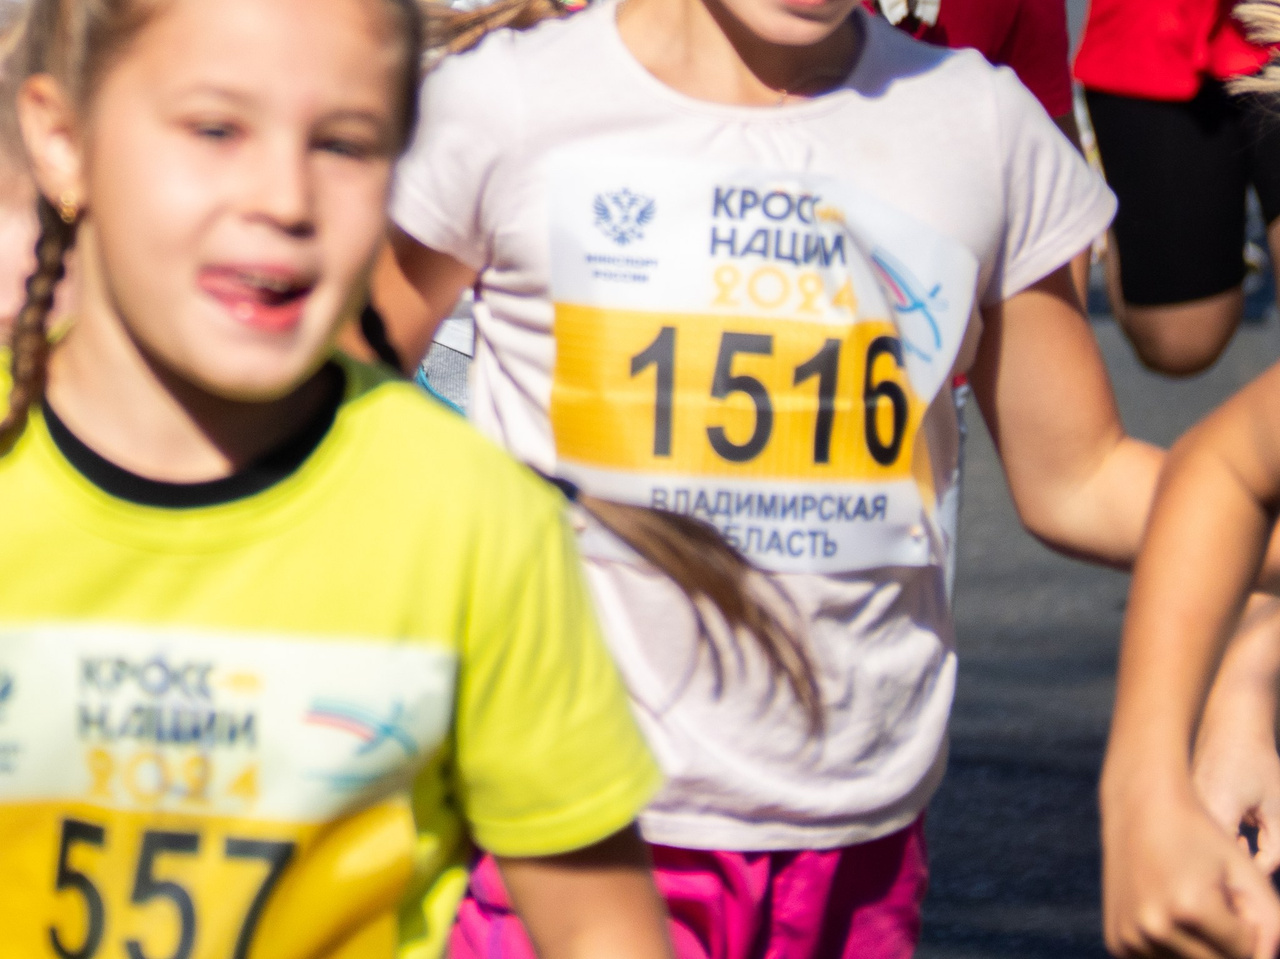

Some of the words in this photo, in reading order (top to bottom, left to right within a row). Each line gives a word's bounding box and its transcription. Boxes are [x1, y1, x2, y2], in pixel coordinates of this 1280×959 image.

[711, 264, 858, 316] 2024
[629, 326, 909, 467] 1516
[651, 487, 888, 522] ВЛАДИМИРСКАЯ
[721, 525, 837, 558] БЛАСТЬ
[86, 747, 259, 808] 2024
[48, 817, 296, 959] 557
